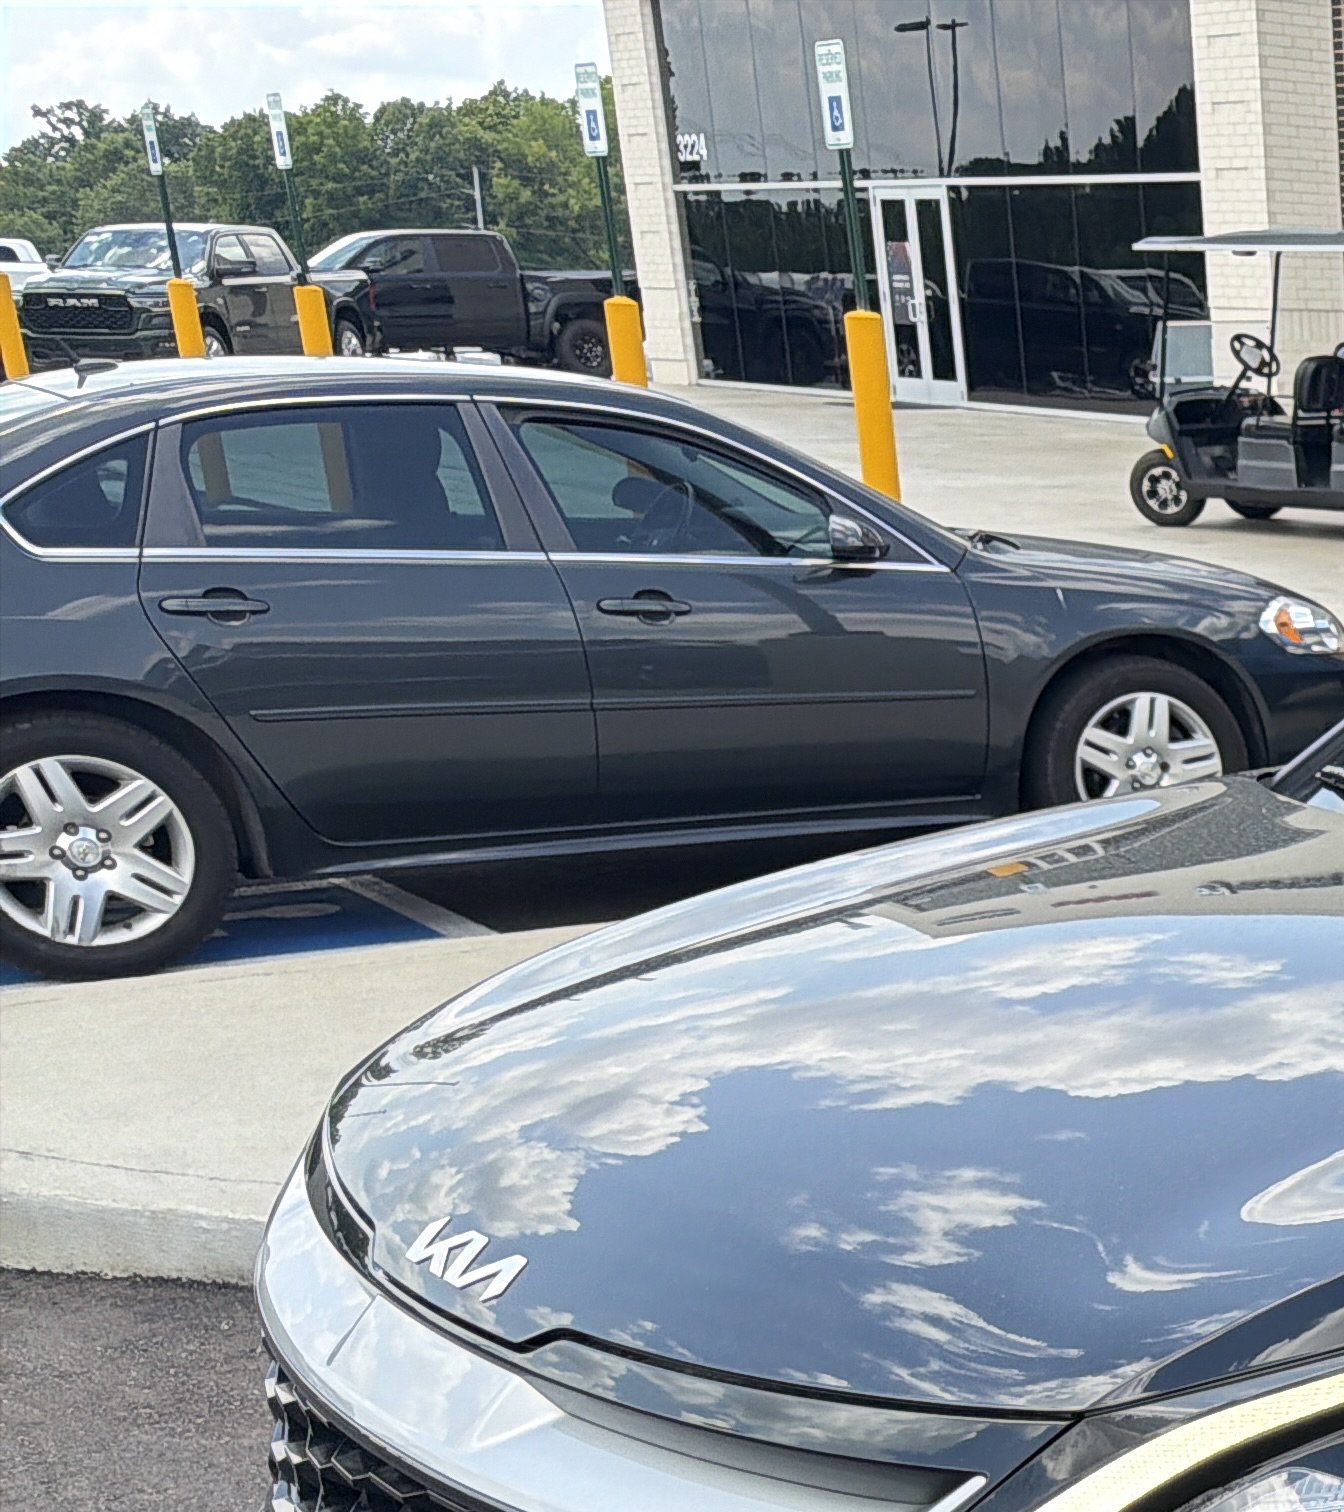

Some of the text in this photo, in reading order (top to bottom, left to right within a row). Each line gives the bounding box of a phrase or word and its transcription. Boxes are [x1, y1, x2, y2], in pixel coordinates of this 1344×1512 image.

[676, 132, 707, 161] 3224
[47, 298, 99, 308] RAM
[405, 1216, 529, 1303] KIA
